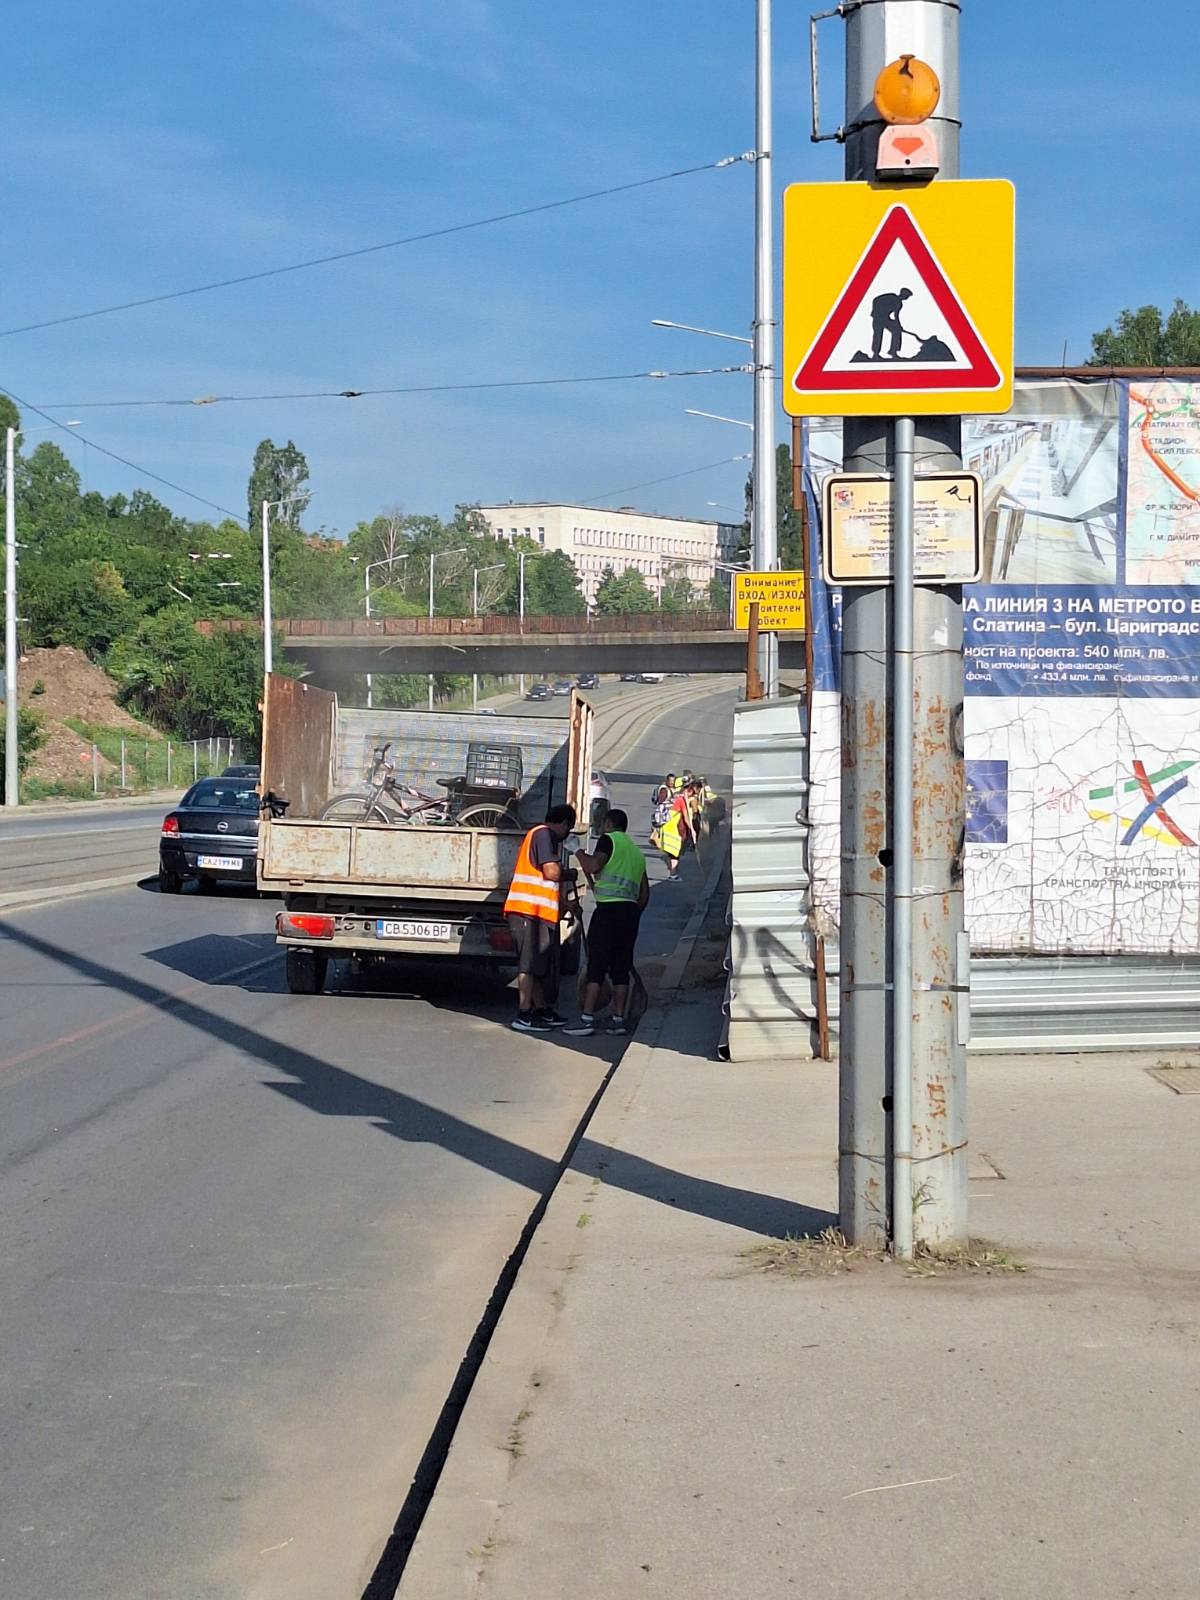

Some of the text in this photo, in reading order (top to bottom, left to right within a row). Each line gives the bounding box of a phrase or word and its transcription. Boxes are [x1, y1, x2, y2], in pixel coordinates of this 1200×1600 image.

[744, 604, 801, 613] соителен
[984, 598, 1048, 613] ЛИНИЯ
[1052, 598, 1063, 613] 3
[1068, 598, 1094, 613] НА
[1098, 598, 1186, 614] МЕТРОТО
[972, 617, 1046, 632] Слатина
[1065, 617, 1102, 636] бул.
[1106, 618, 1200, 637] Цариградс
[1000, 647, 1017, 658] на
[1020, 647, 1080, 661] проекта:
[1083, 645, 1110, 658] 540
[1113, 647, 1145, 659] млн.
[1148, 648, 1170, 659] лв.
[385, 923, 448, 937] CB 5306 BP
